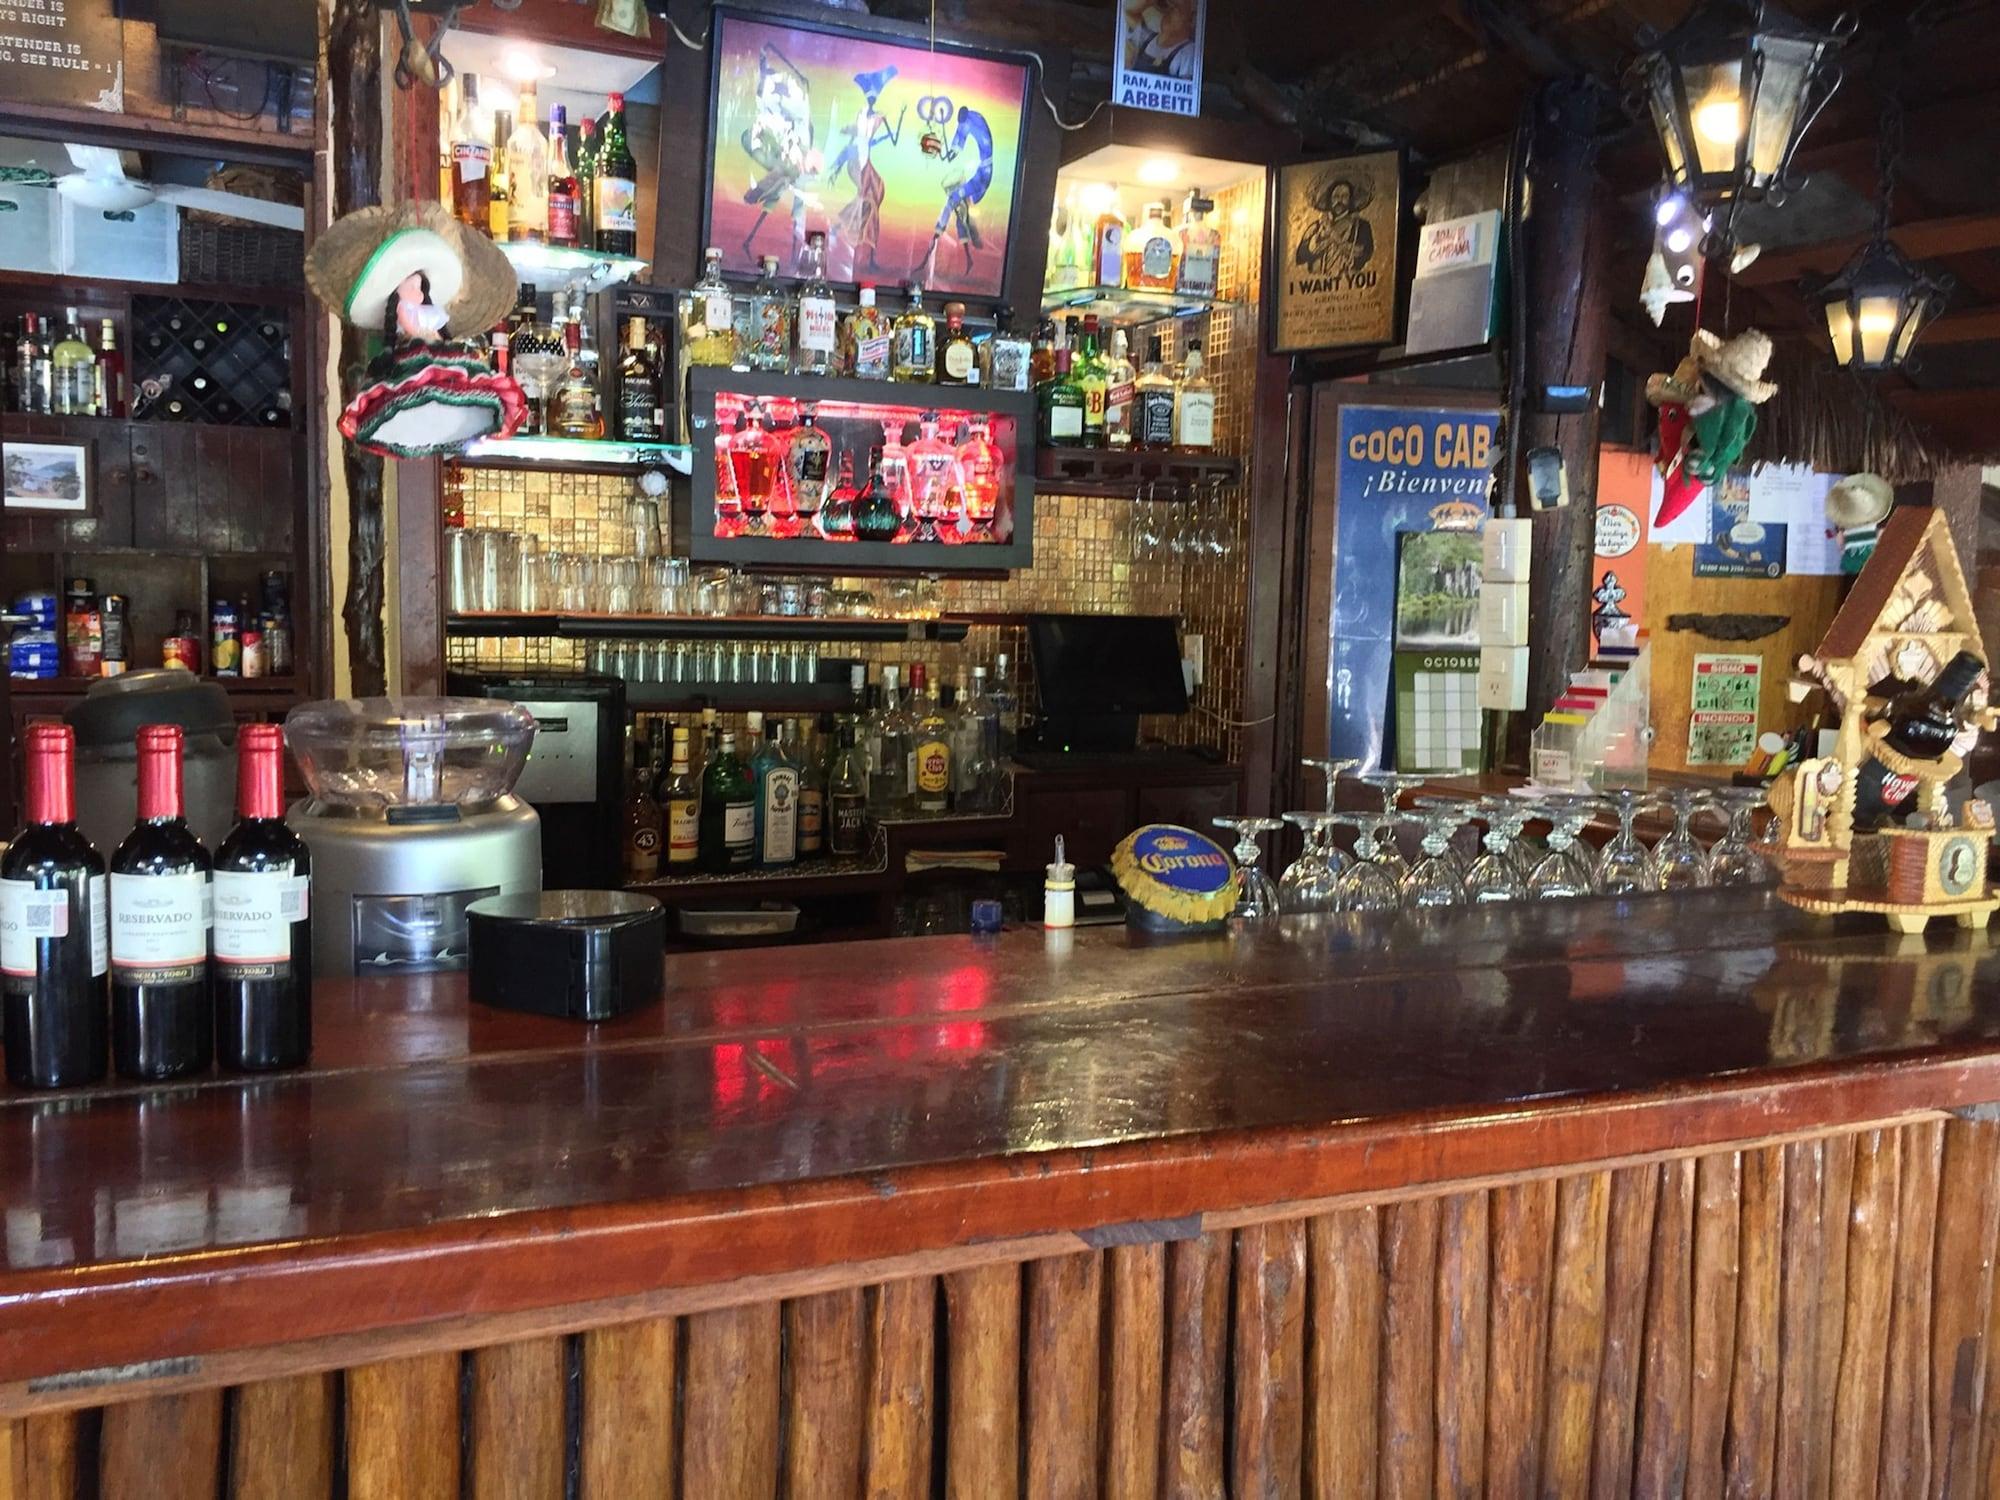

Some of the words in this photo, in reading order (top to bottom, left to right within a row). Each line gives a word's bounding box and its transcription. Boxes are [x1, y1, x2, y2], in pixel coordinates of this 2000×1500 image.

[50, 2, 64, 12] IS
[22, 12, 67, 27] RIGHT
[67, 43, 81, 55] IS
[21, 53, 47, 66] SEE
[52, 56, 90, 70] RULE
[1123, 74, 1151, 90] RAN,
[1155, 80, 1171, 91] AN
[1174, 82, 1193, 95] DIE
[1122, 89, 1192, 113] ARBEIT!
[1289, 281, 1294, 296] I
[1299, 277, 1341, 295] WANT
[1346, 270, 1377, 290] YOU
[1349, 424, 1424, 467] COCO
[1698, 713, 1751, 724] INCENDIO
[638, 833, 655, 847] 43
[1141, 853, 1224, 875] Corona
[118, 911, 193, 925] RESERVADO
